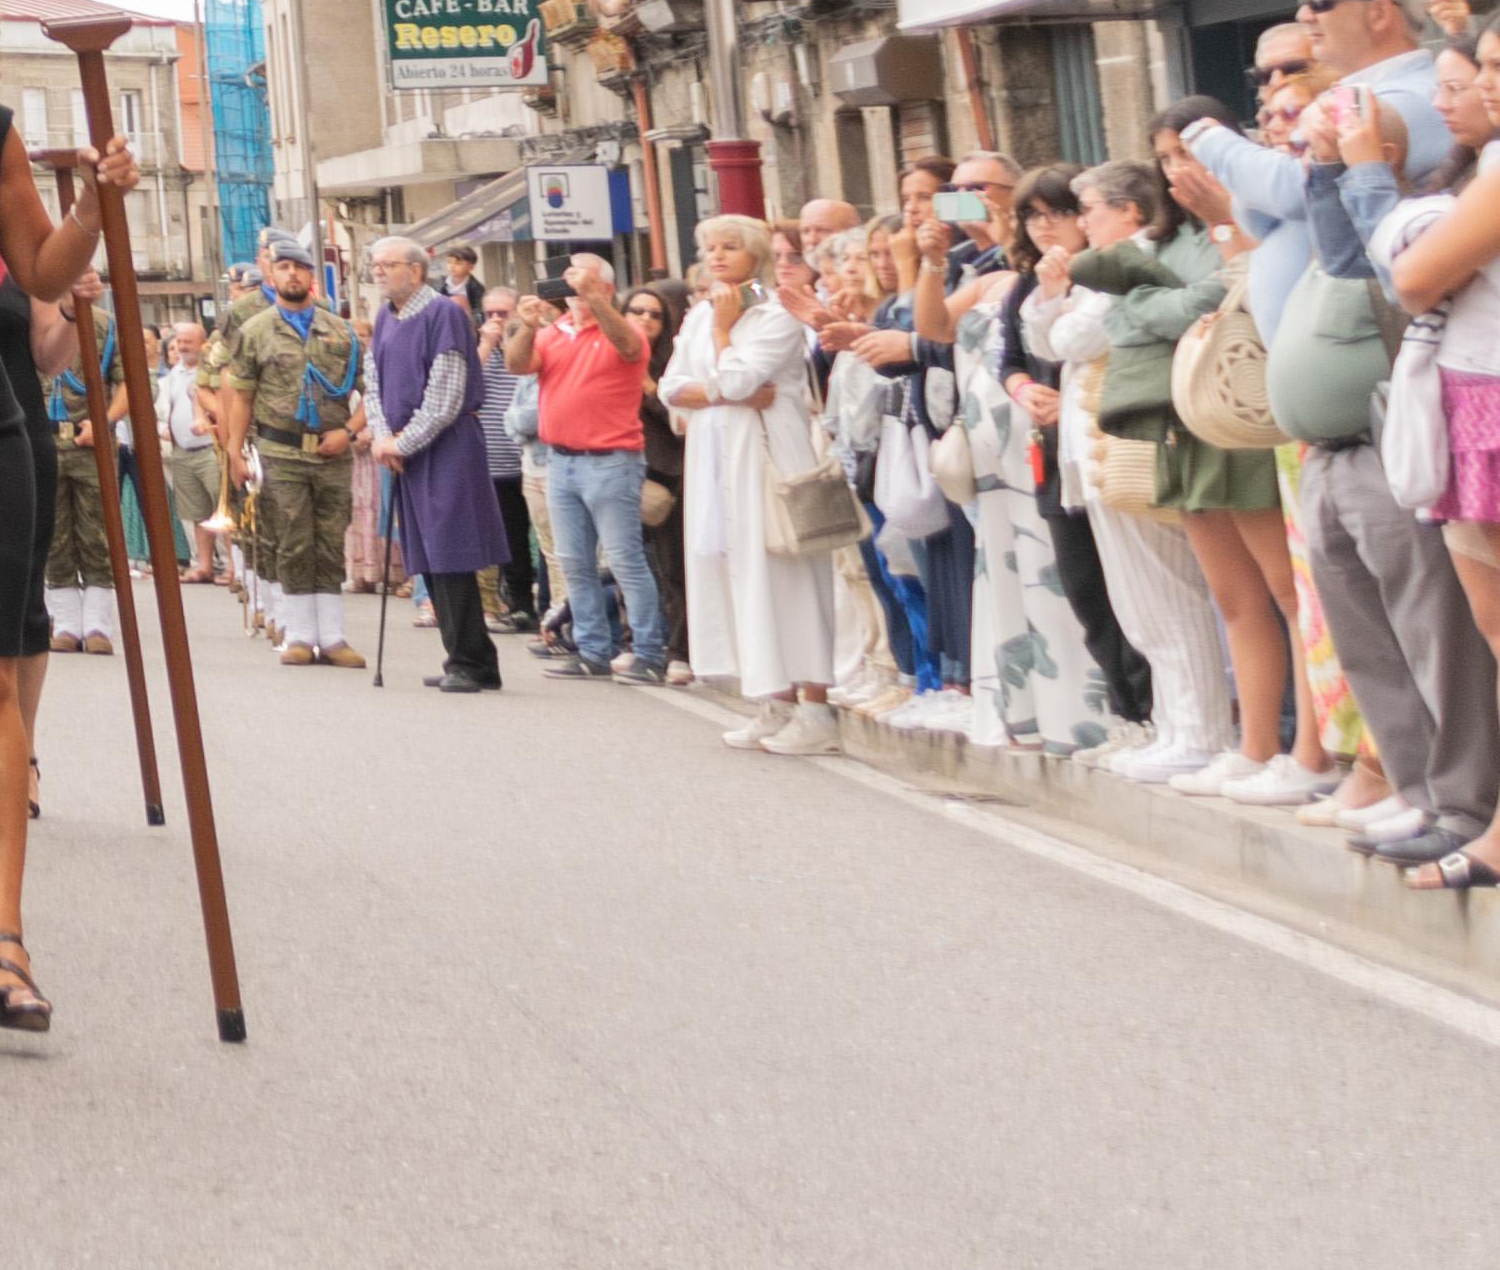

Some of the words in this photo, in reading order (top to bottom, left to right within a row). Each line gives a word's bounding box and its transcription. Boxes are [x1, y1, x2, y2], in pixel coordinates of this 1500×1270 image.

[394, 23, 517, 49] Resero
[397, 65, 446, 80] Abierto
[450, 64, 467, 78] 24
